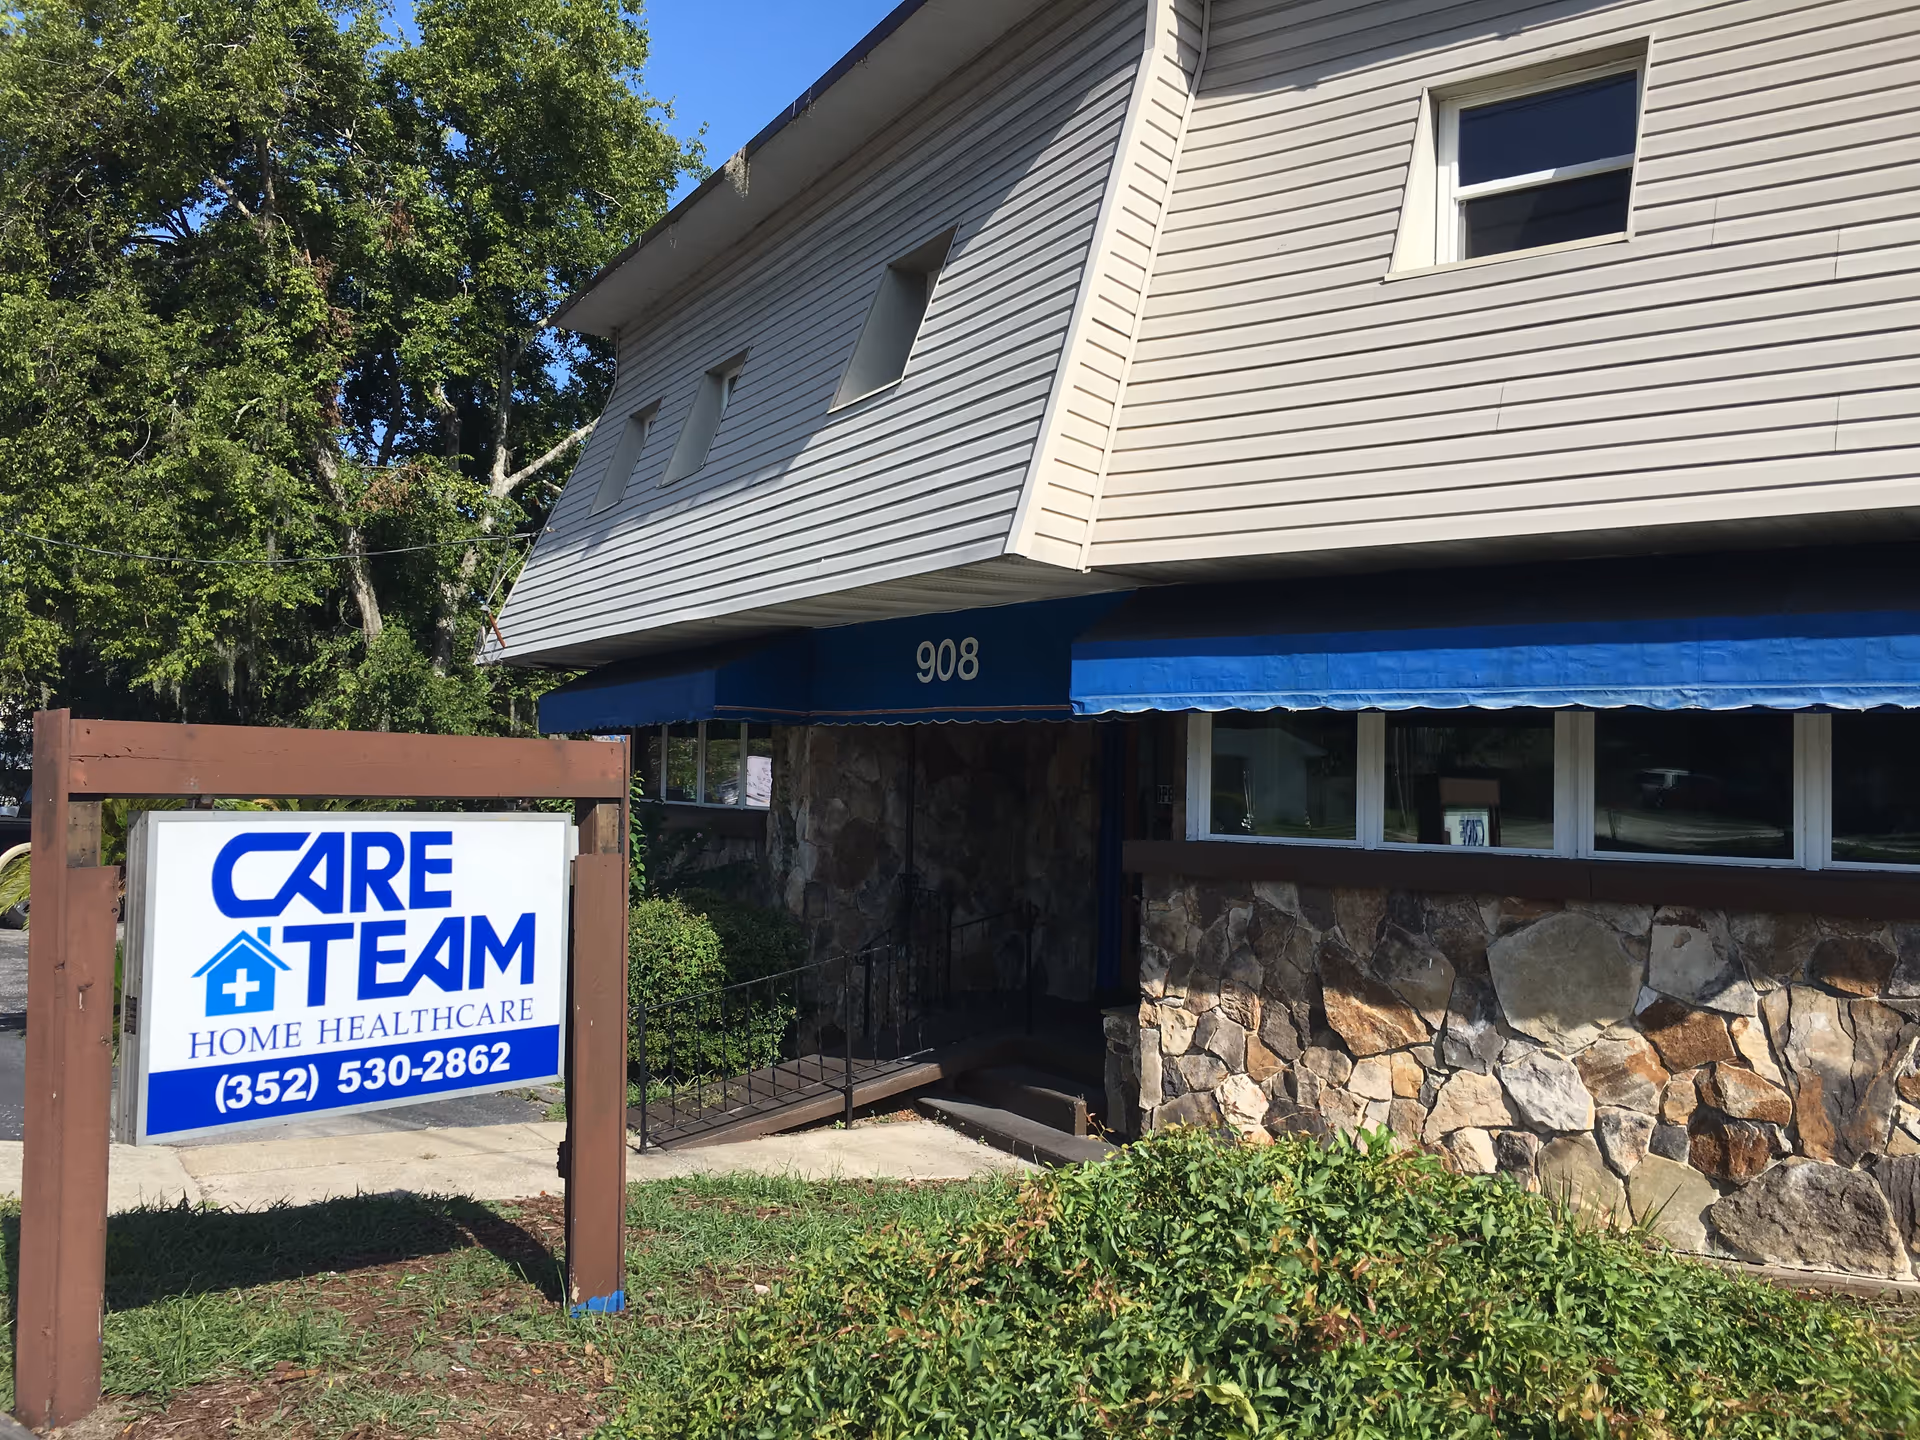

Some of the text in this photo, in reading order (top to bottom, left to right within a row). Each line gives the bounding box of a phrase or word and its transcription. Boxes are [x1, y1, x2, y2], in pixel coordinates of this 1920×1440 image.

[916, 637, 979, 683] 908
[211, 831, 452, 919] CARE
[282, 912, 536, 1007] TEAM
[188, 997, 535, 1060] HOME HEALTHCARE
[215, 1042, 511, 1113] (352) 530-2862
